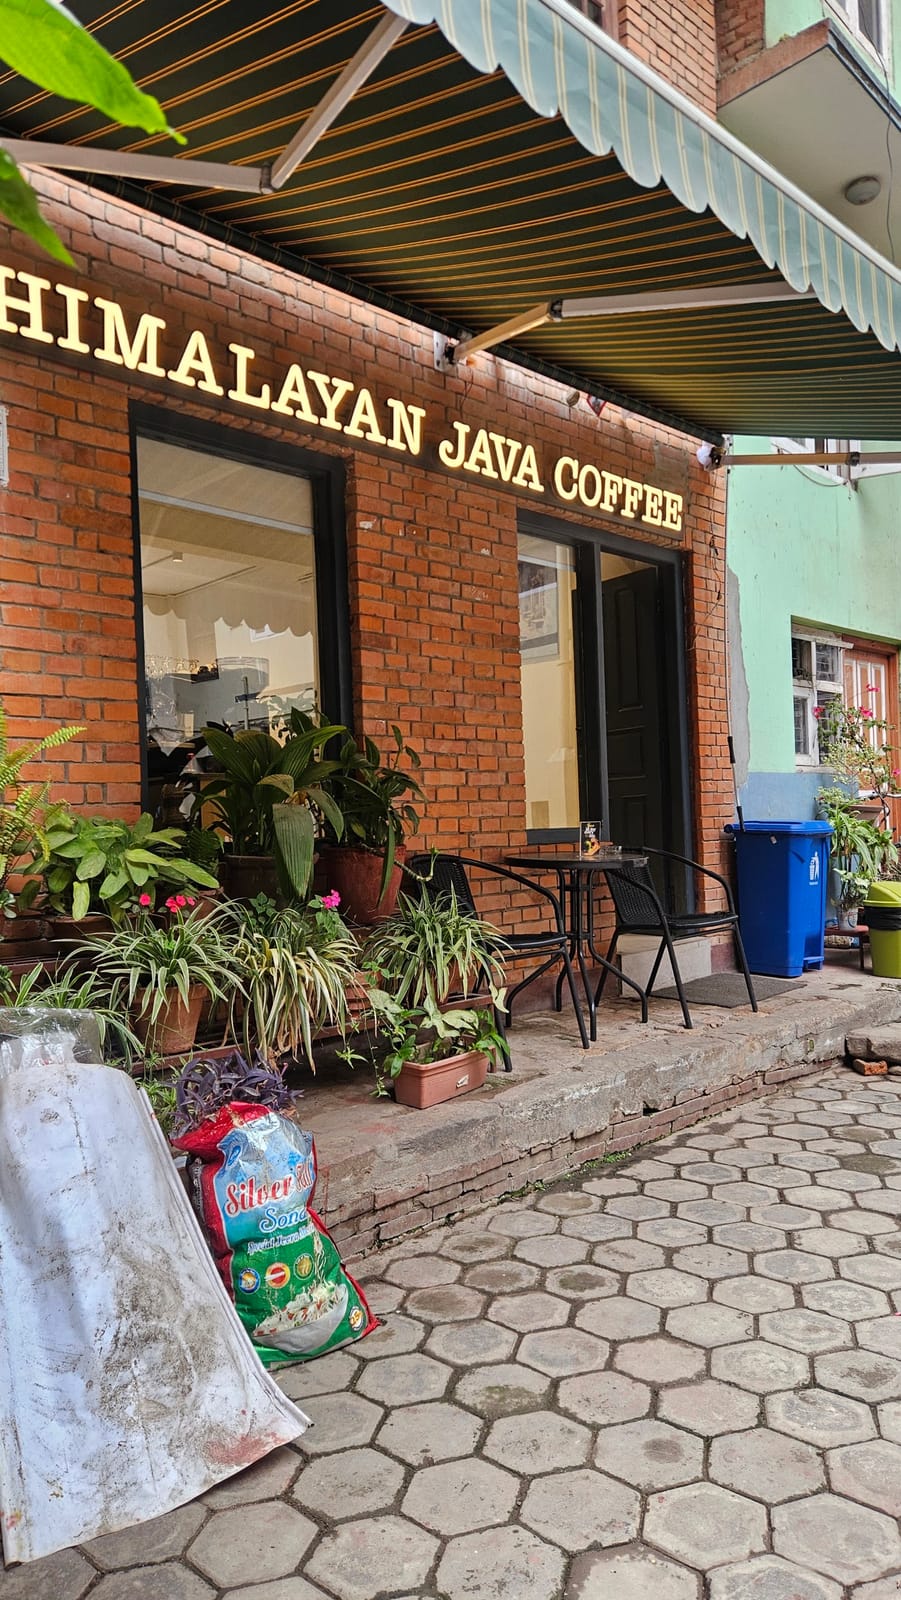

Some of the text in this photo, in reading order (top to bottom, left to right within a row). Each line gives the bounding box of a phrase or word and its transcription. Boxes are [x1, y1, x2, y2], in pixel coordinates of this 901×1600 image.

[0, 265, 684, 533] HIMALAYAN JAVA COFFEE
[226, 1175, 294, 1216] Silver
